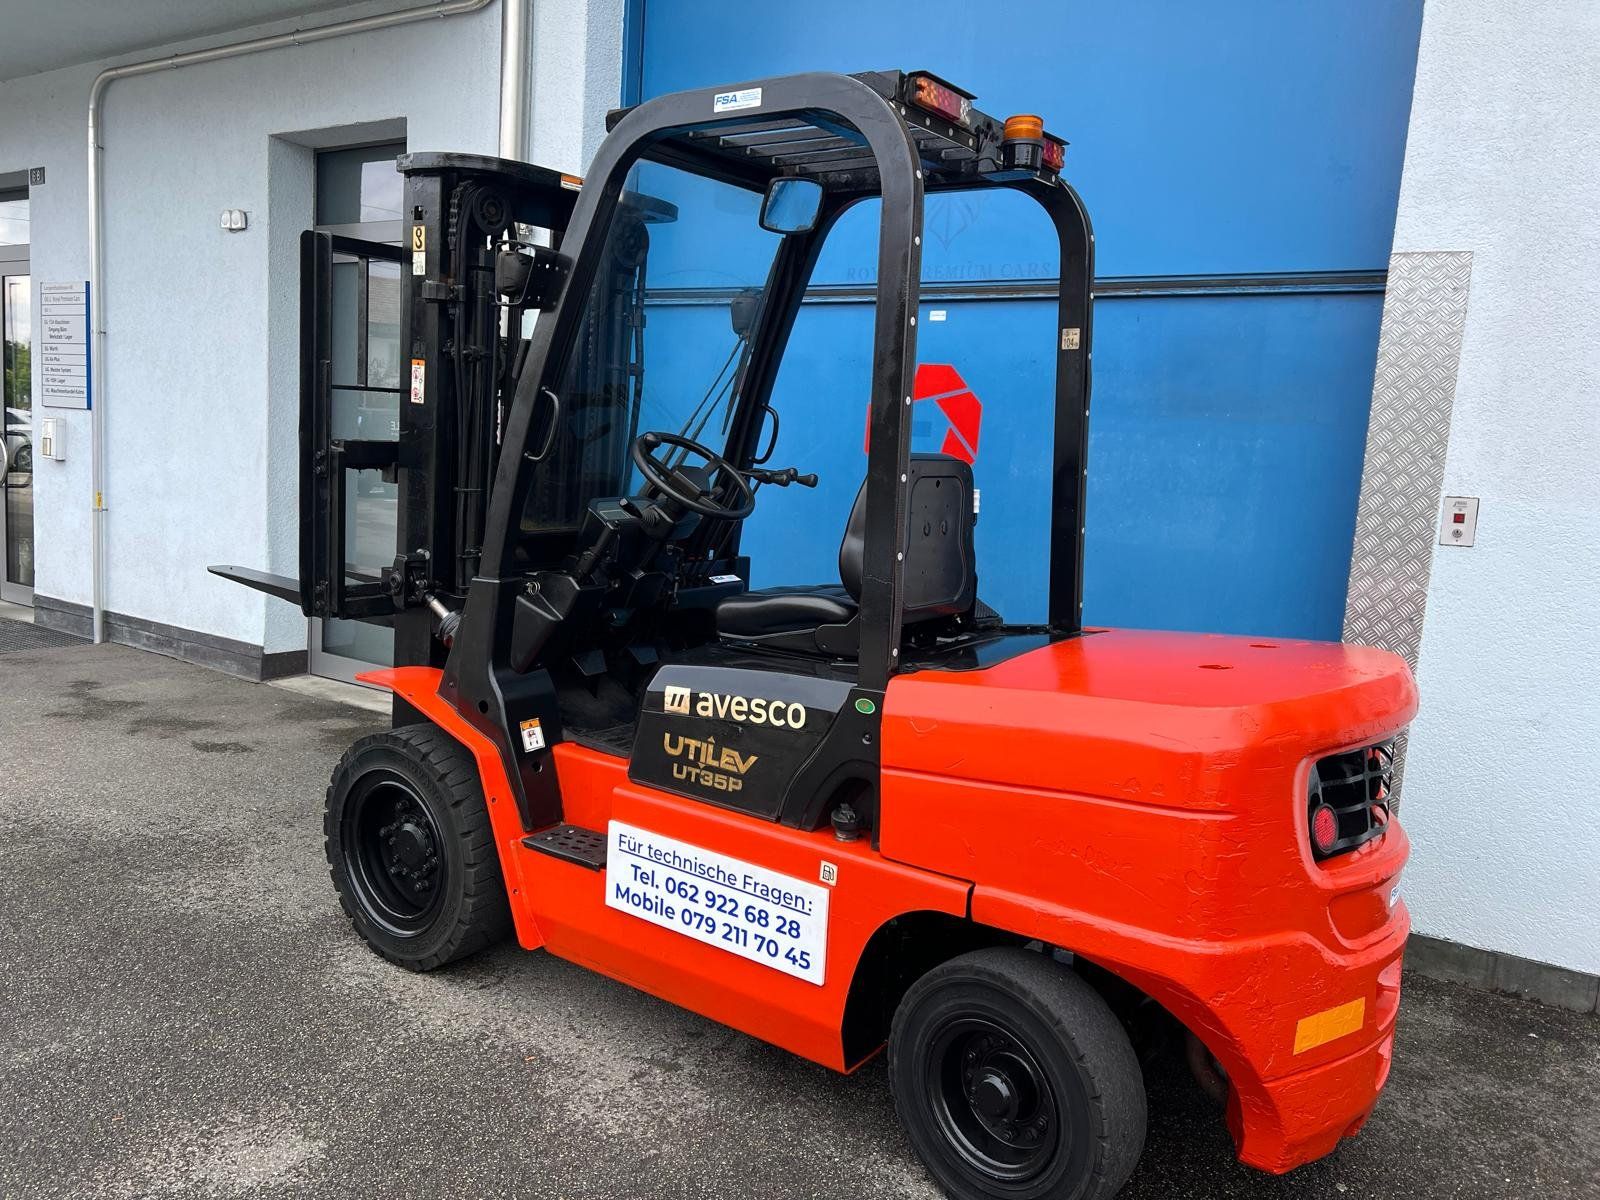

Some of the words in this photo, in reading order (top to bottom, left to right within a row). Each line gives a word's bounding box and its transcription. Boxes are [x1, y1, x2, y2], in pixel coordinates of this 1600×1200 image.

[715, 94, 738, 106] FSA
[1000, 261, 1051, 278] CARS
[696, 692, 807, 730] avesco
[663, 731, 761, 775] UTILEV
[672, 762, 743, 793] UT35P
[617, 833, 644, 854] Für
[647, 845, 738, 886] technische
[742, 874, 813, 912] Fragen:
[630, 863, 660, 890] Tel.
[665, 876, 699, 904] 062
[705, 890, 739, 918] 922
[744, 905, 770, 928] 68
[775, 915, 801, 939] 28
[615, 883, 676, 920] Mobile
[681, 908, 717, 935] 079
[721, 922, 748, 947] 211
[753, 934, 779, 958] 70
[784, 946, 811, 970] 45
